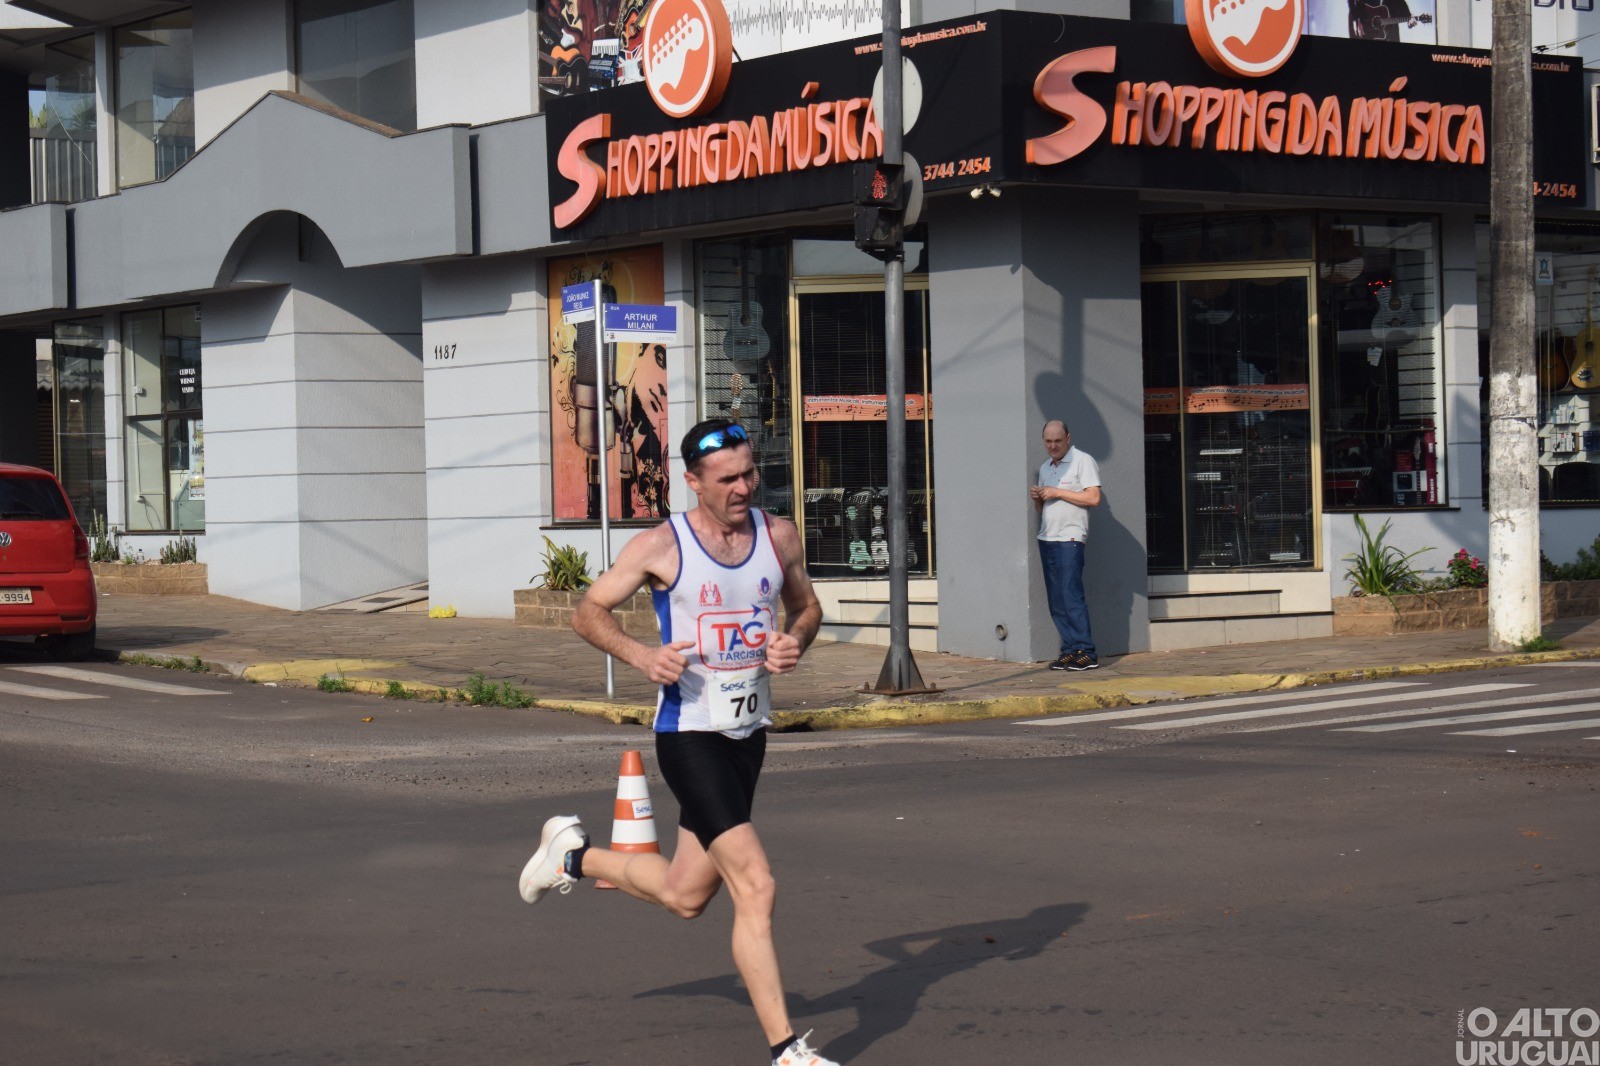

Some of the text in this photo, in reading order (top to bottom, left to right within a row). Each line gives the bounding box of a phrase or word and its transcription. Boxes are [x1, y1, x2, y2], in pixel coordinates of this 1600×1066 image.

[854, 20, 987, 55] www.singdamusica.com.br
[923, 156, 991, 181] 3744 2454
[624, 313, 658, 322] ARTHUR
[627, 321, 655, 330] MILANI
[434, 342, 457, 360] 1187
[711, 621, 767, 651] TAG
[718, 648, 763, 661] TARCISO
[730, 692, 758, 718] 70
